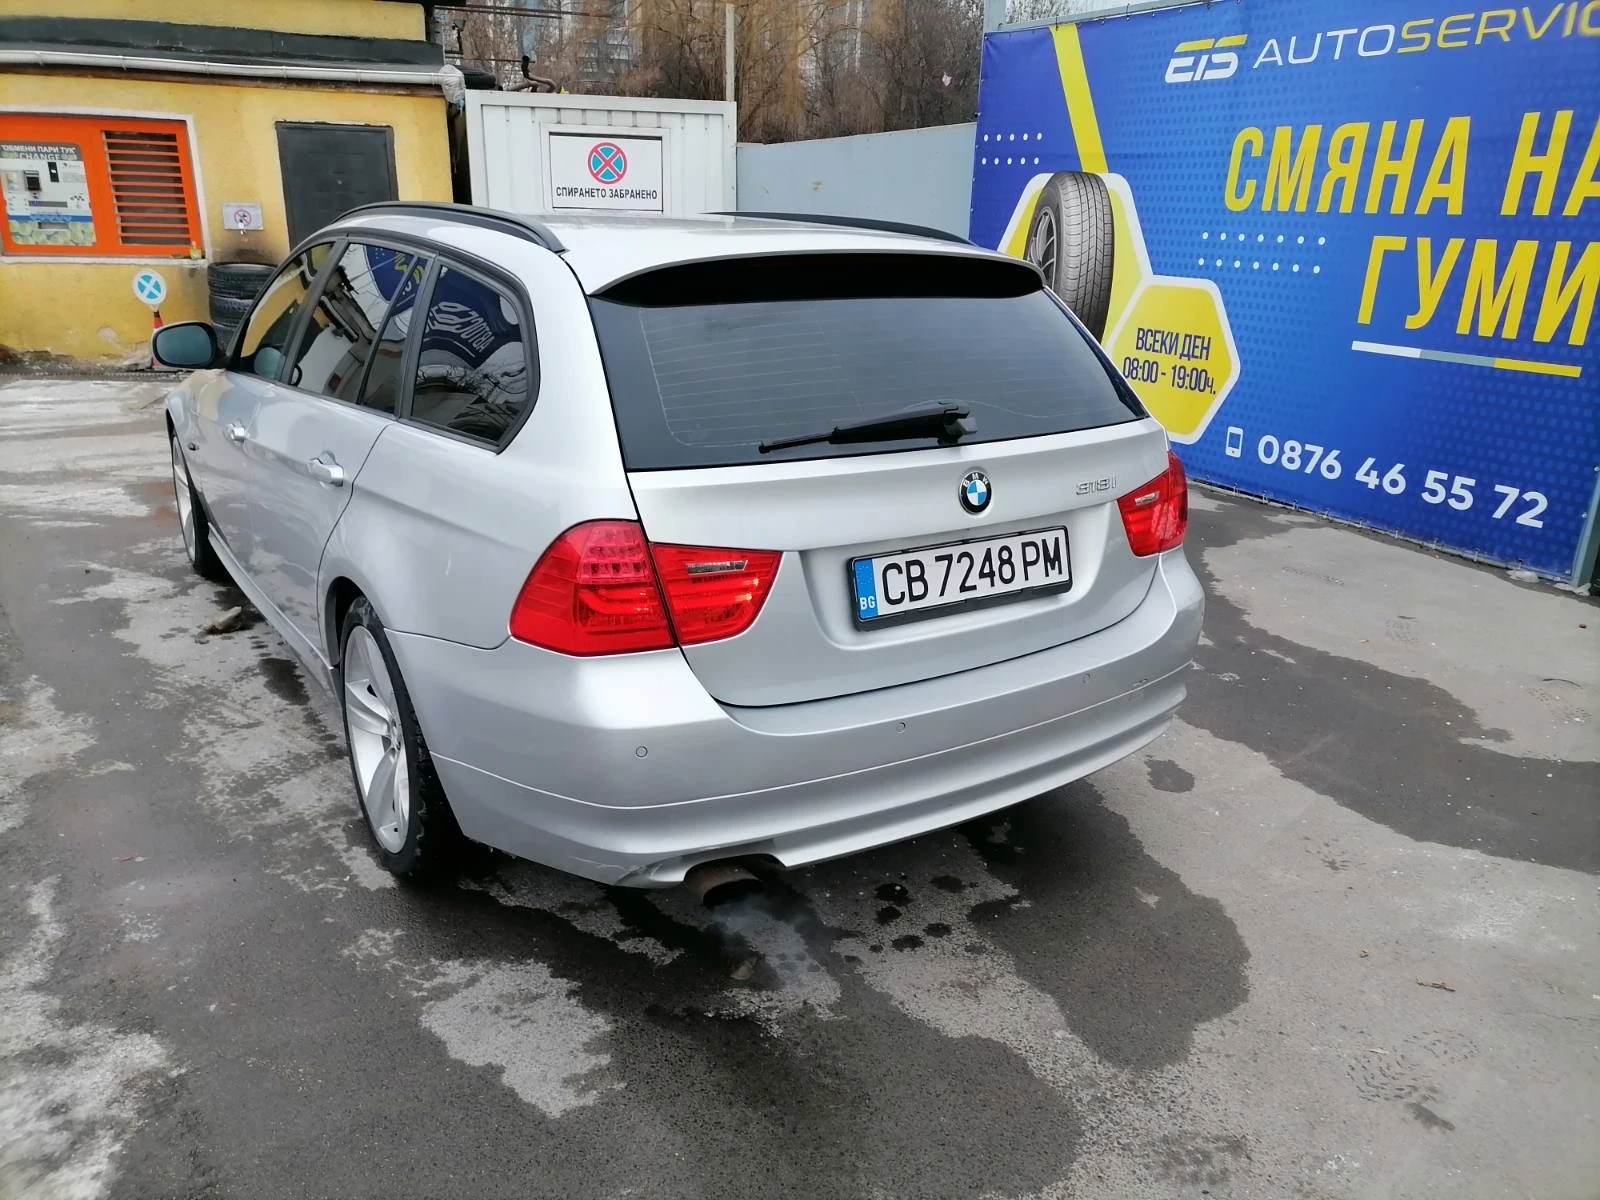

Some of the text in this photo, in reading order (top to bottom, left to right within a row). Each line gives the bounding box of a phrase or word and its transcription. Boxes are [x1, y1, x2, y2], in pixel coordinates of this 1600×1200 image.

[19, 152, 60, 160] CHANGE
[1224, 110, 1600, 216] СМЯНА НА
[556, 186, 658, 200] СПИРАНЕТО ЗАБРАНЕНО
[1357, 235, 1600, 346] ГУМИ
[1135, 328, 1211, 361] ВСЕКИ ДЕН
[1122, 356, 1159, 383] 08:00
[1171, 364, 1216, 395] 19:00ч.
[963, 473, 988, 487] BMW
[1257, 435, 1548, 529] 0876 46 55 72
[882, 537, 1063, 606] CB 7248 PM
[859, 596, 876, 611] BG
